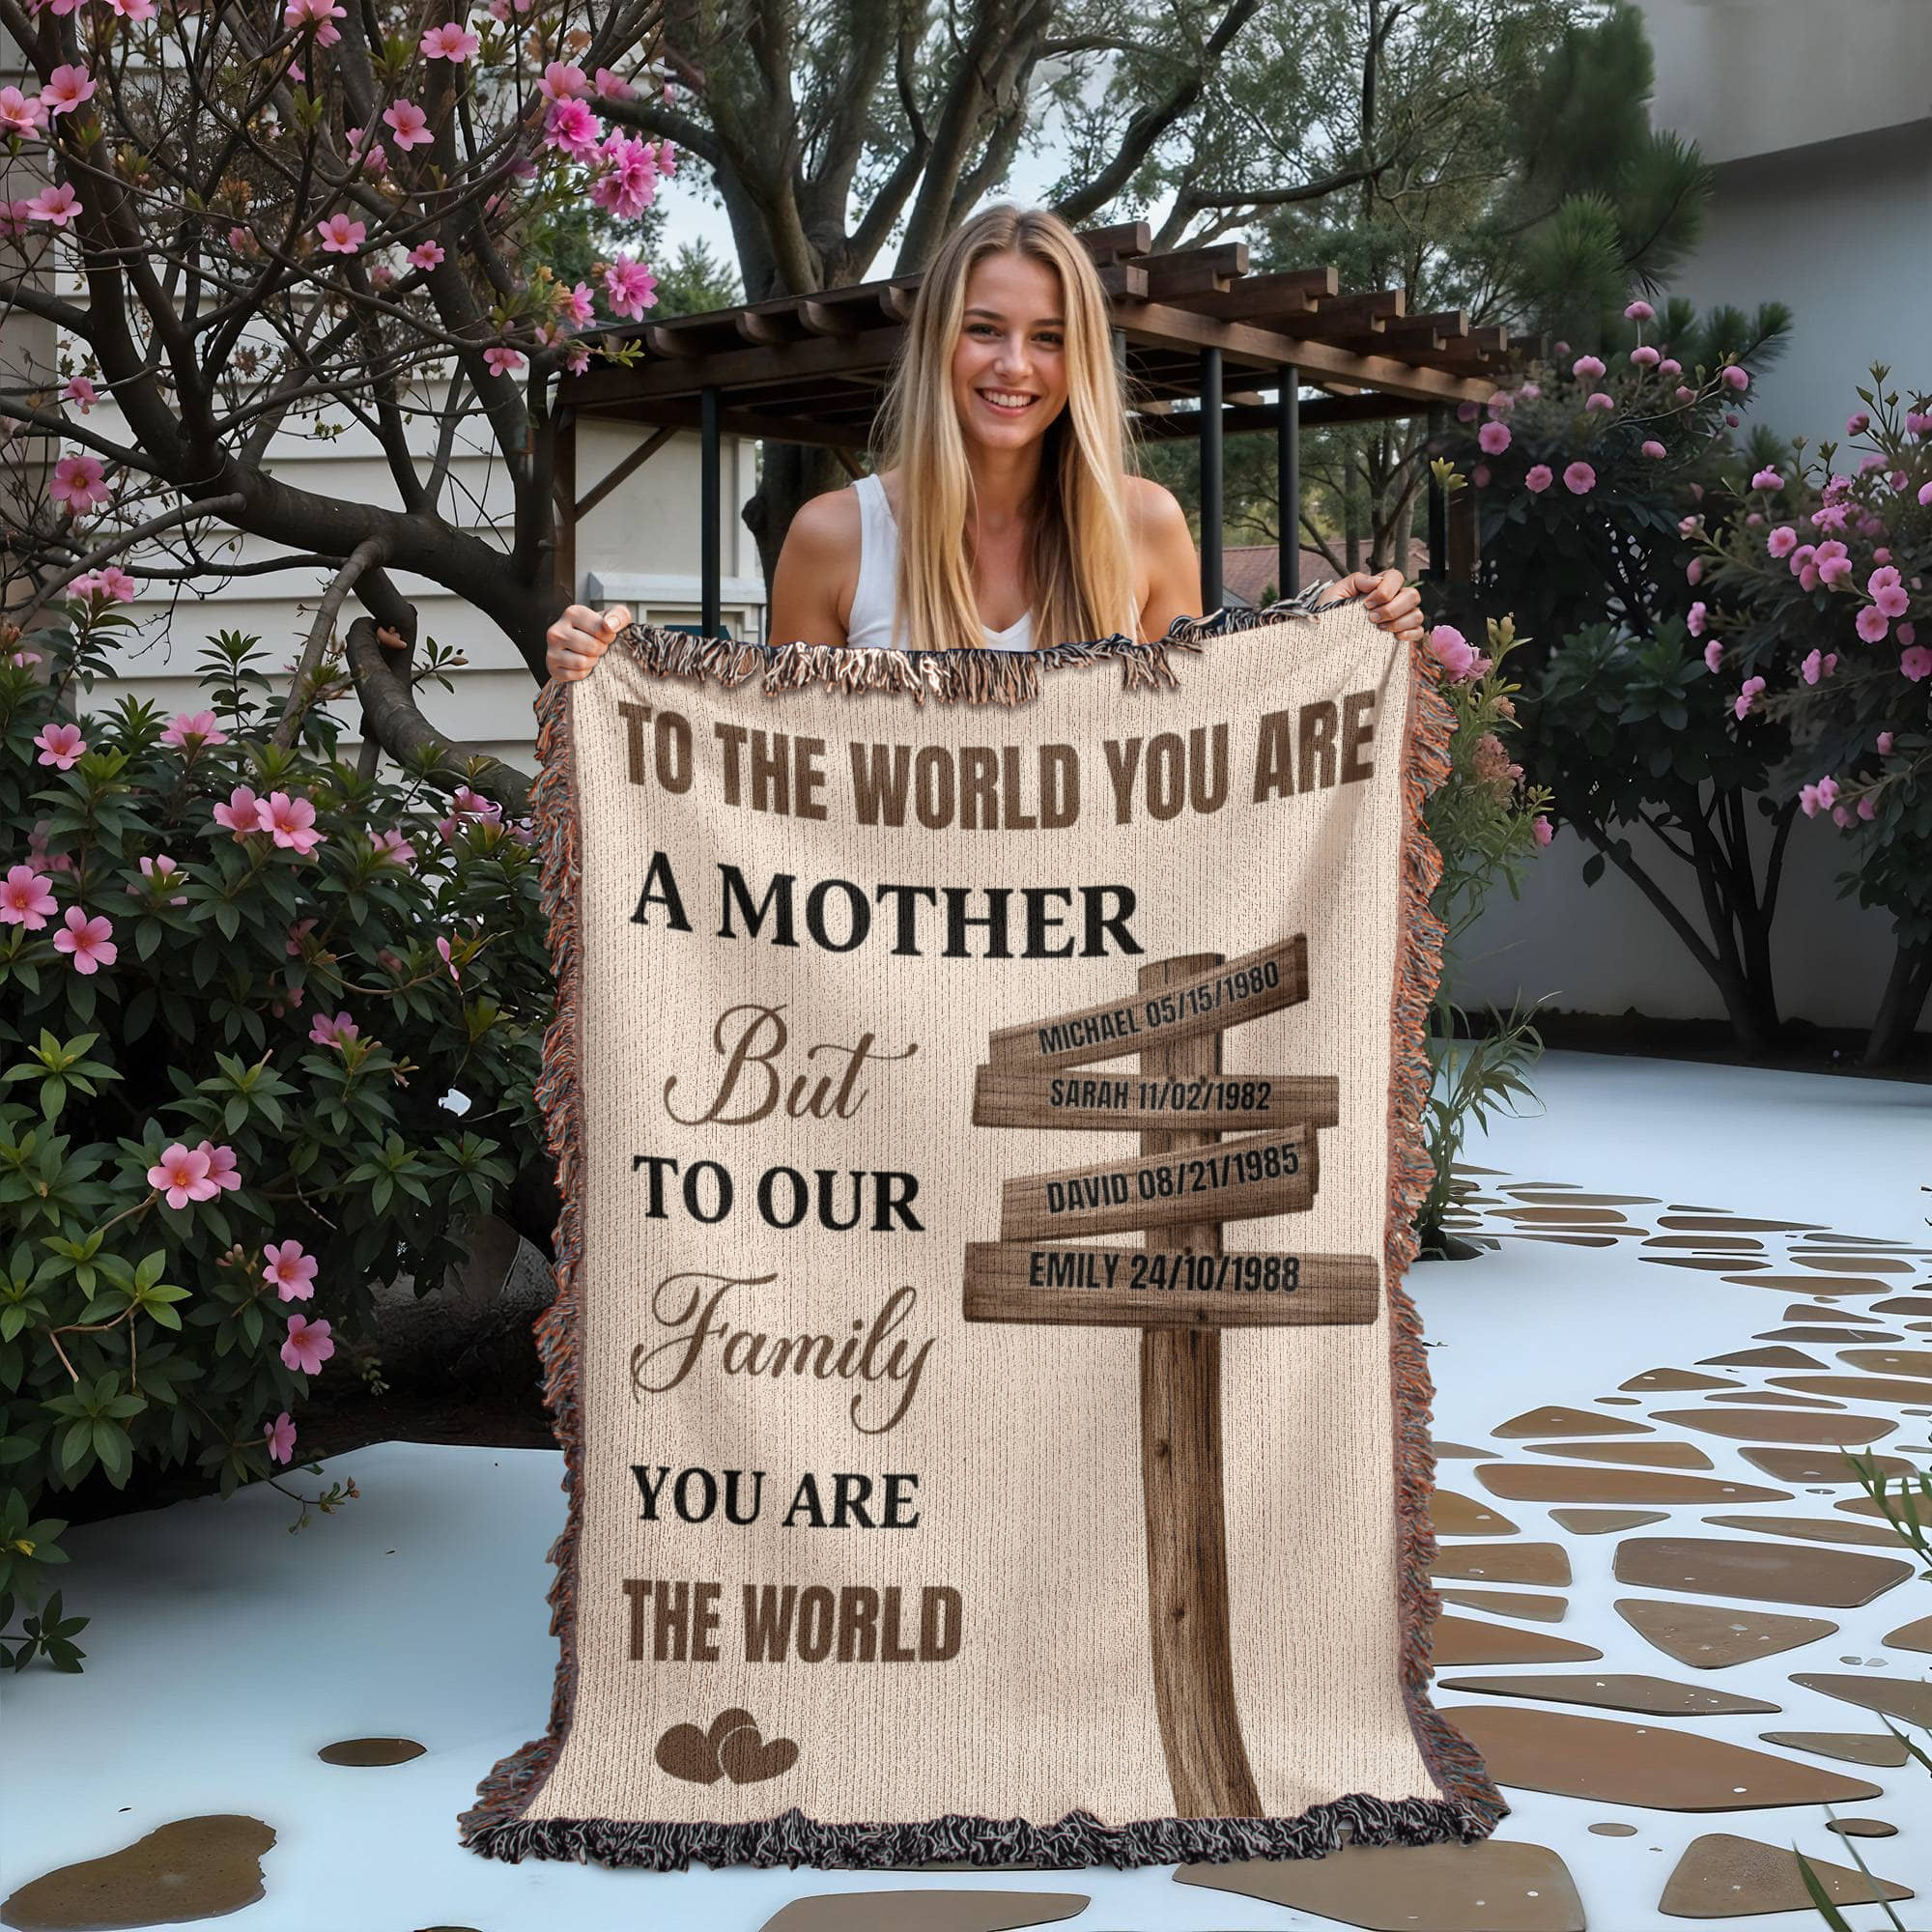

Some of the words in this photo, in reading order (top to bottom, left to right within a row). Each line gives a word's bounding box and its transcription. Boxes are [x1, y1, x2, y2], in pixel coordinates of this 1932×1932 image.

[618, 700, 693, 795] TO
[714, 723, 827, 821] THE
[850, 743, 1080, 831] WORLD
[1103, 723, 1229, 822] YOU
[1253, 690, 1376, 803] ARE
[630, 852, 693, 932] A
[717, 864, 1145, 958] MOTHER
[1038, 1009, 1141, 1054] MICHAEL
[1147, 960, 1280, 1028] 05/15/1980
[664, 1004, 918, 1126] But
[1050, 1079, 1128, 1109] SARAH
[1139, 1081, 1272, 1111] 11/02/1982
[633, 1155, 734, 1224] TO
[757, 1166, 925, 1232] OUR
[1046, 1173, 1128, 1213] DAVID
[1139, 1143, 1299, 1202] 08/21/1985
[1029, 1252, 1121, 1289] EMILY
[1129, 1255, 1300, 1293] 24/10/1988
[631, 1272, 936, 1435] Family
[630, 1464, 767, 1527] YOU
[782, 1472, 921, 1529] ARE
[622, 1578, 722, 1662] THE
[743, 1584, 963, 1663] WORLD
